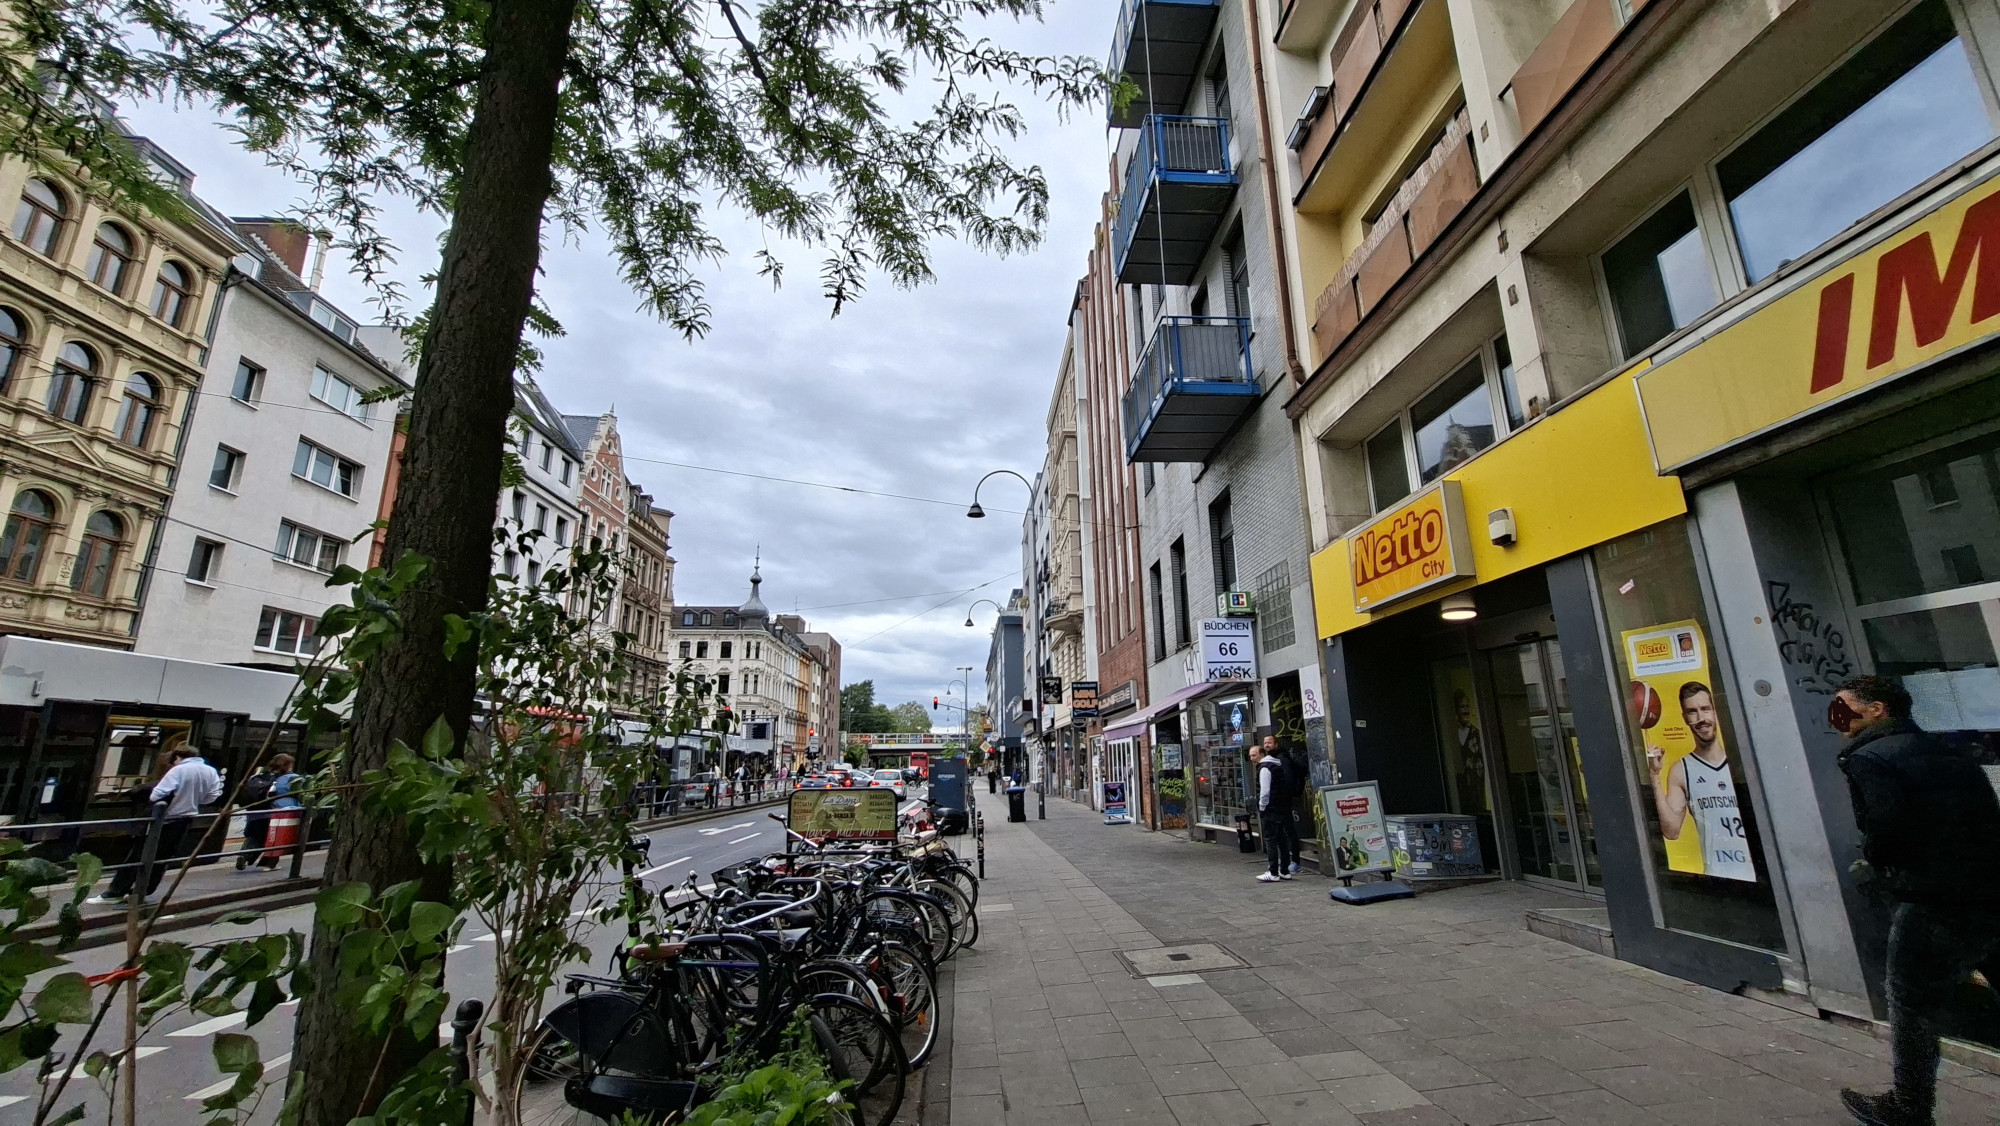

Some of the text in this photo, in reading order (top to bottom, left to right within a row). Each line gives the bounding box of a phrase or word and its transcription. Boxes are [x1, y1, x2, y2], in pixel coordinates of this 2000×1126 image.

[1355, 508, 1444, 588] Netto
[1421, 559, 1446, 579] City
[1204, 620, 1250, 631] BÜDCHEN
[1218, 642, 1239, 656] 66
[1640, 642, 1668, 655] Netto
[1208, 667, 1252, 680] KIOSK
[1072, 699, 1099, 709] GOLF
[1720, 816, 1746, 839] 42
[1715, 849, 1746, 863] ING
